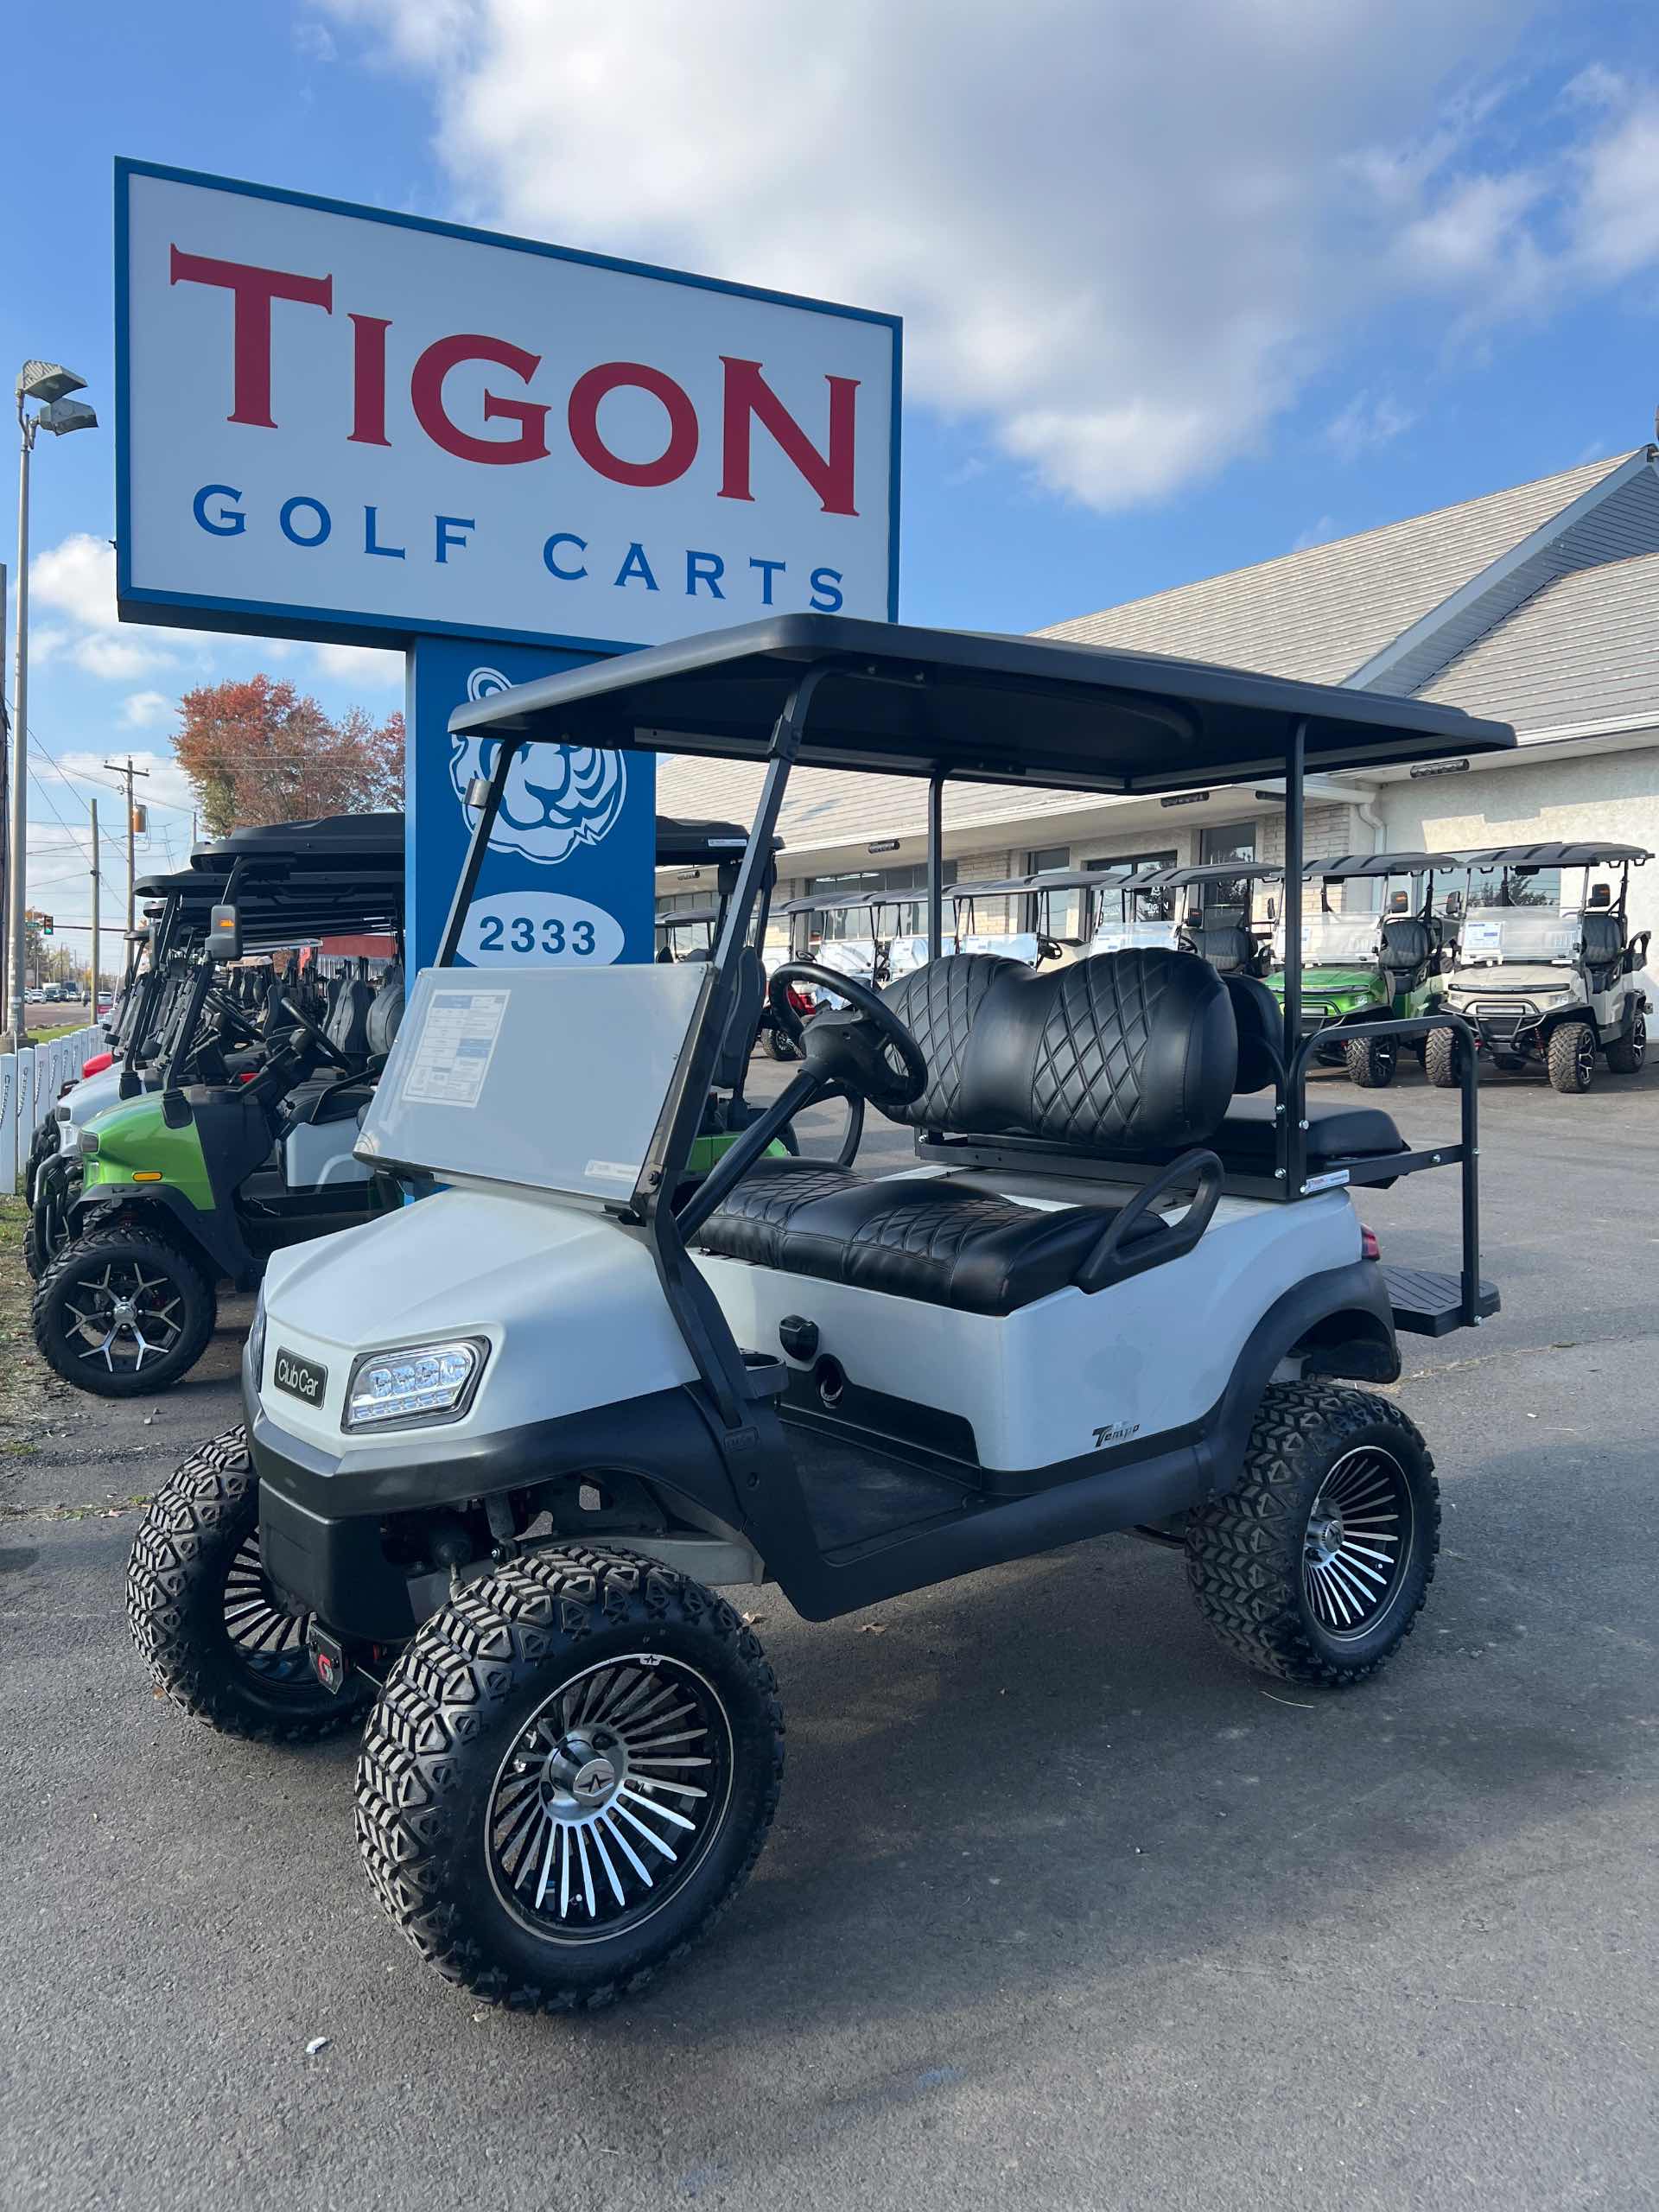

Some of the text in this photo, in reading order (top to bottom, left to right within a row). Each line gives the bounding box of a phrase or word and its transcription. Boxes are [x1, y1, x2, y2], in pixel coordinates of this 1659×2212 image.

[170, 245, 860, 516] TIGON
[193, 484, 844, 613] GOLF CARTS
[479, 915, 596, 956] 2333
